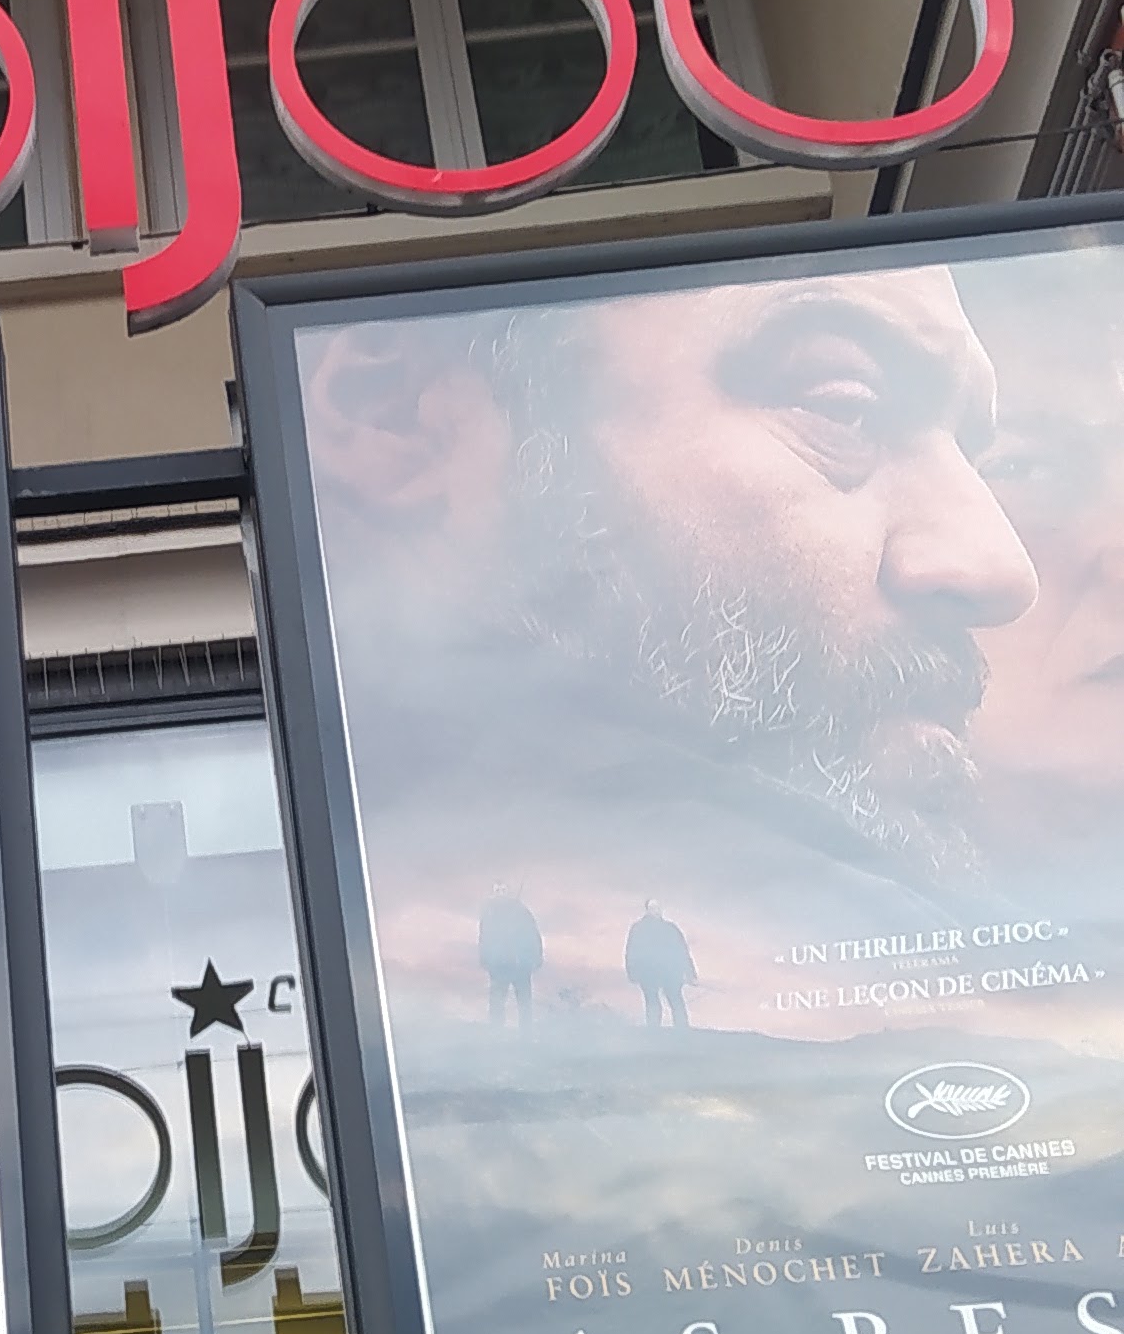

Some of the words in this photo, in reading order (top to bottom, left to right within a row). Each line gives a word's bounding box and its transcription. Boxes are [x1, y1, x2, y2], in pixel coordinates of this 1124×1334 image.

[791, 942, 827, 966] UN
[834, 928, 966, 962] THRILLER
[972, 919, 1053, 948] CHOC
[776, 989, 828, 1013] UNE
[837, 977, 931, 1009] LEÇON
[938, 973, 976, 998] DE
[981, 959, 1091, 992] CINÉMA
[864, 1149, 959, 1172] FESTIVAL
[960, 1147, 989, 1166] DE
[991, 1139, 1076, 1163] CANNES
[900, 1168, 965, 1187] CANNES
[968, 1161, 1051, 1181] PREMIÈRE
[542, 1247, 628, 1270] Marina
[734, 1235, 804, 1256] Denis
[967, 1219, 1021, 1238] Luis
[545, 1269, 633, 1302] FOÏS
[663, 1251, 886, 1294] MÉNOCHET
[916, 1238, 1085, 1274] ZAHERA
